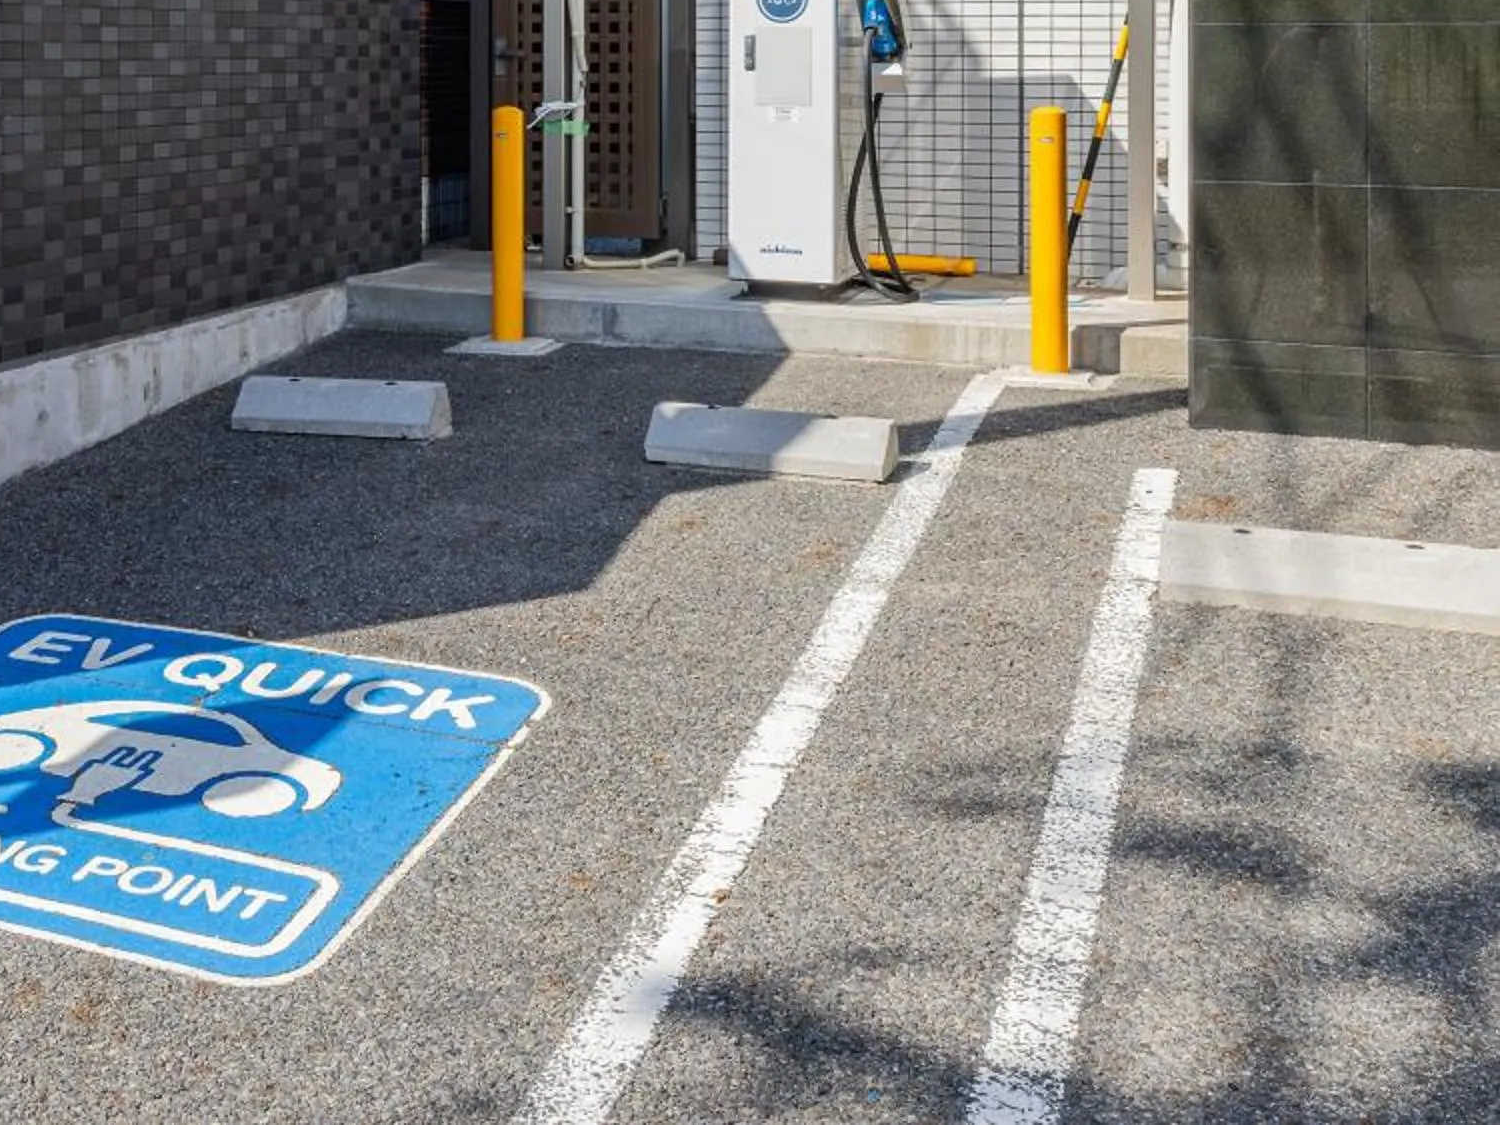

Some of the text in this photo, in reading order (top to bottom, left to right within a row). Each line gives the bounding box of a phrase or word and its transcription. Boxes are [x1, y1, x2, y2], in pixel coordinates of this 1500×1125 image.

[8, 630, 497, 729] EV QUICK
[72, 856, 288, 920] POINT
